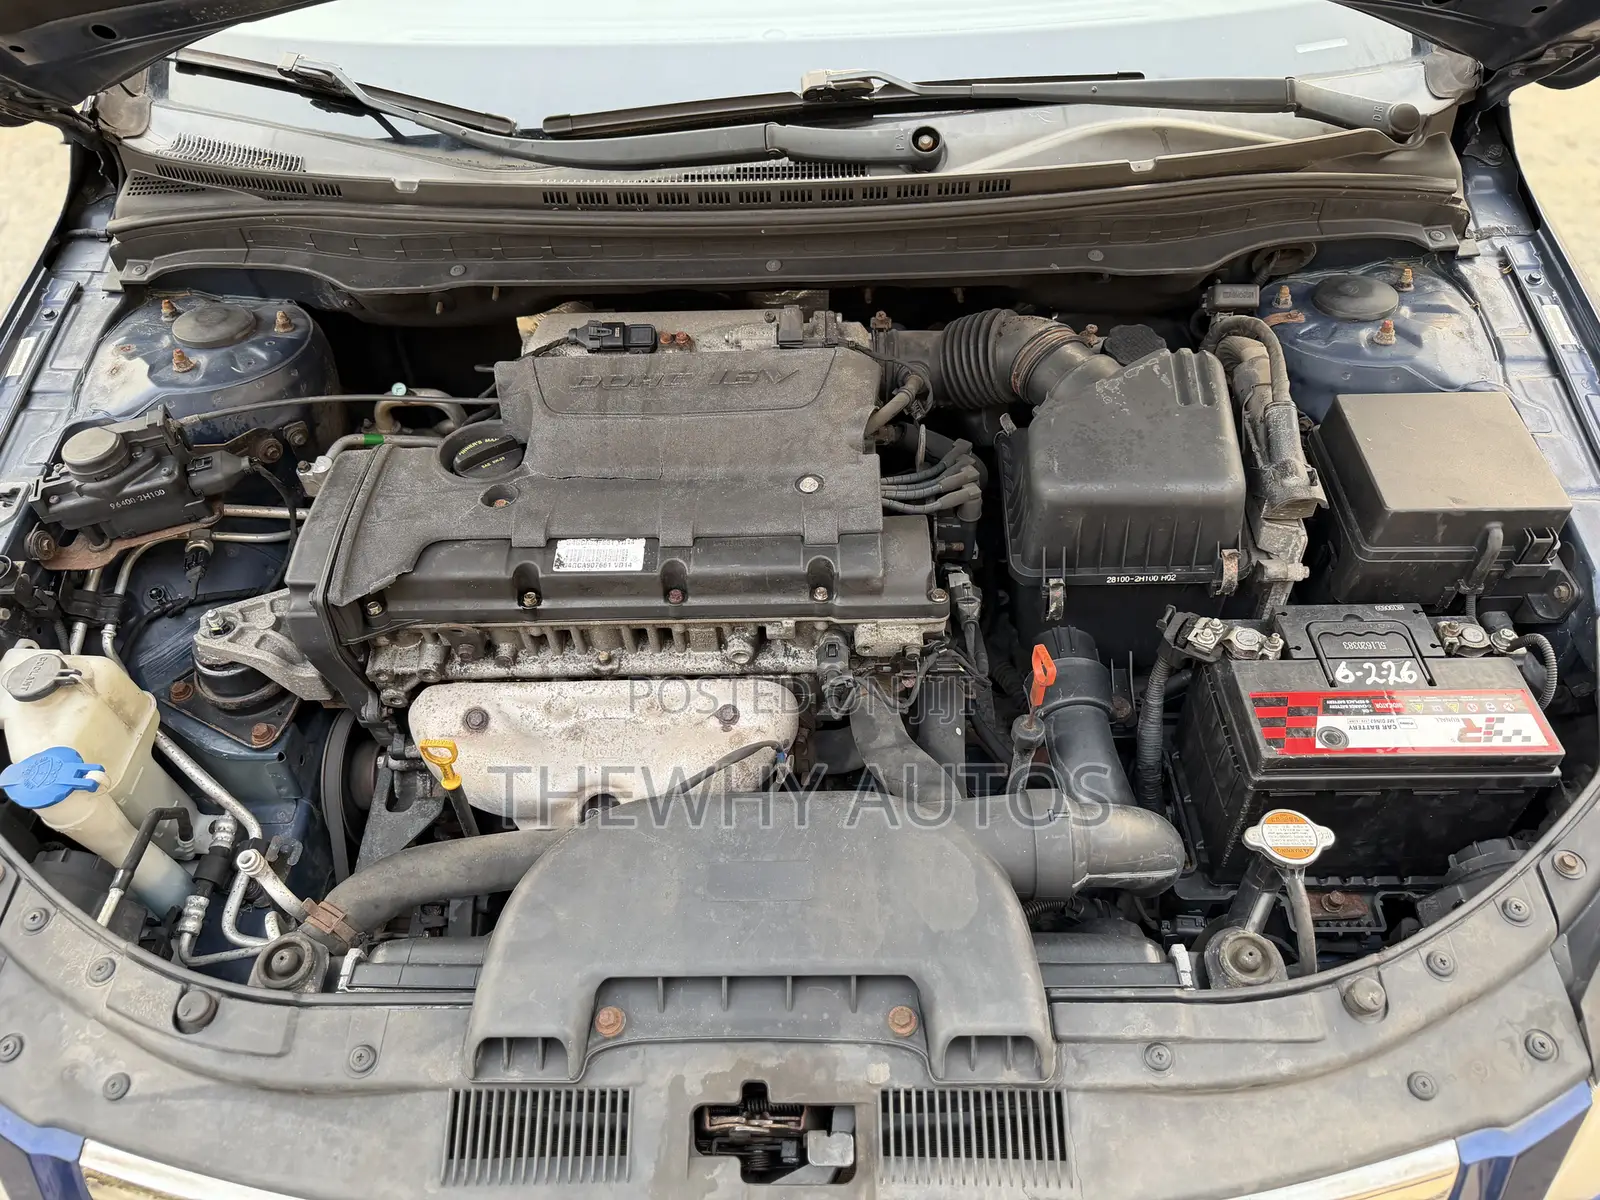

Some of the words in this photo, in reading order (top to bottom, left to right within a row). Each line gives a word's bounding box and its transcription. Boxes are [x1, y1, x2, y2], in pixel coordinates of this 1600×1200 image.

[109, 488, 166, 510] 96400-2H100
[1106, 575, 1159, 584] 28100-2H100
[1342, 640, 1387, 650] 5L1620383
[20, 656, 49, 692] COOLANT
